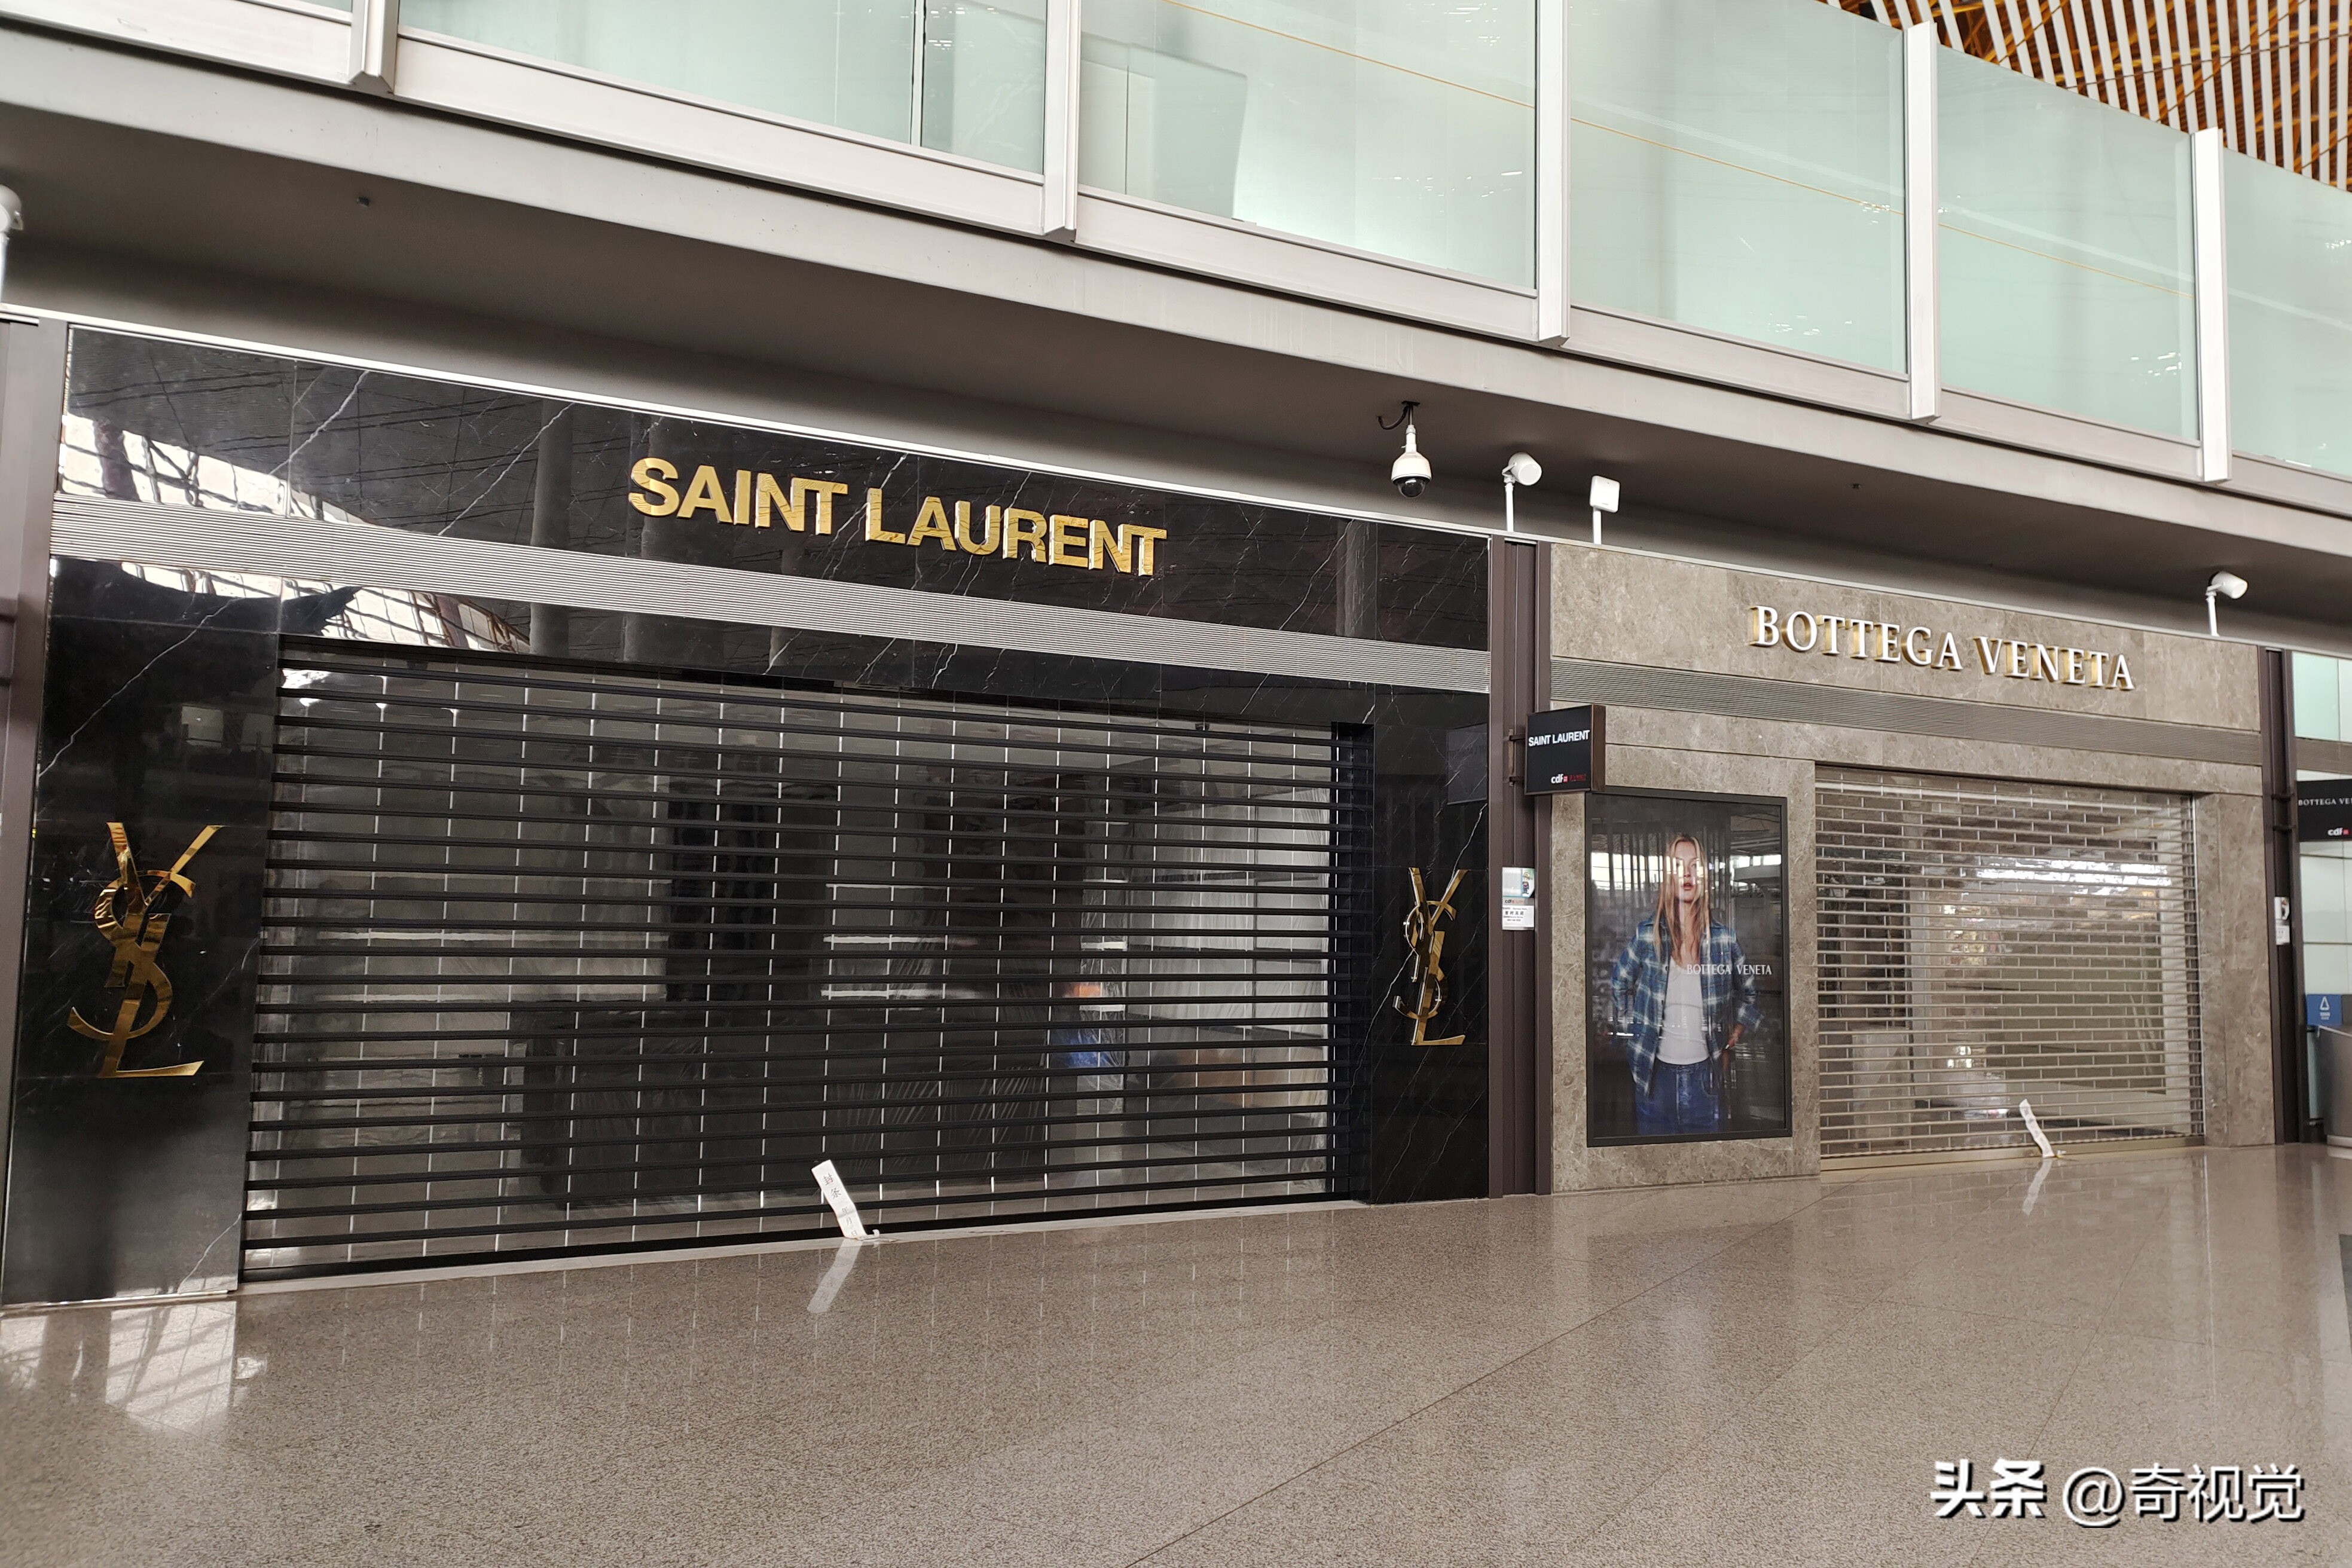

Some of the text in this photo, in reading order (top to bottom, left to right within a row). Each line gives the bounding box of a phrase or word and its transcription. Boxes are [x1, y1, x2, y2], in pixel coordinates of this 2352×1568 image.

[628, 457, 1168, 576] SAINT LAURENT
[1749, 604, 2135, 690] BOTTEGA VENETA
[1528, 730, 1590, 747] SAINT LAURENT
[1551, 774, 1563, 784] cdf
[1687, 964, 1772, 975] BOTTEGA VENETA
